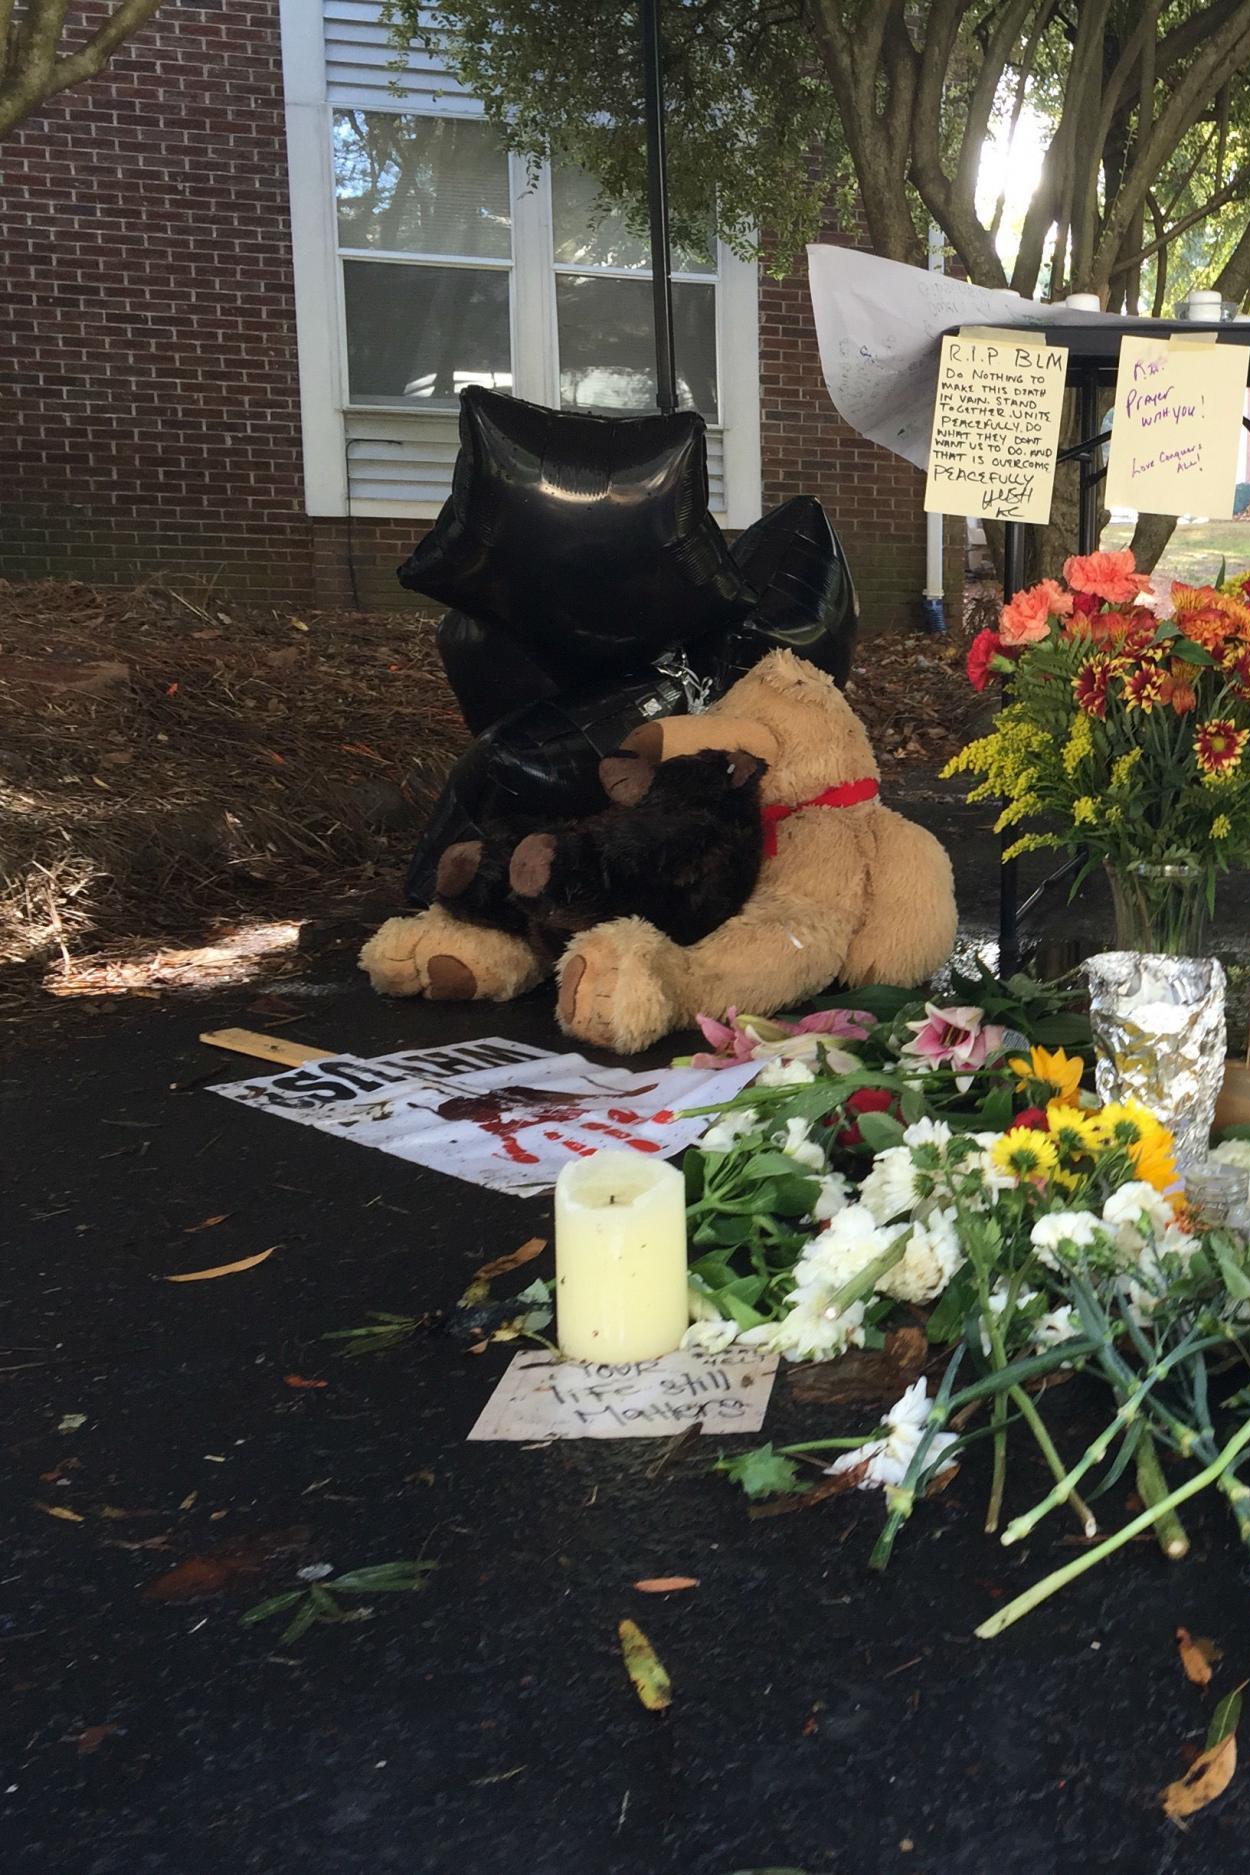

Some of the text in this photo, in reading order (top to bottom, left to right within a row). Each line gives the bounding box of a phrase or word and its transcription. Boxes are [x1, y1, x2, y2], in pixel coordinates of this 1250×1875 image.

[1014, 347, 1063, 372] BLM
[1031, 375, 1045, 385] TO
[940, 381, 1047, 398] MAKE THIS DEATH
[939, 392, 1037, 410] IN VAIN. STAND
[1026, 421, 1042, 432] DO
[937, 428, 972, 440] WHAT
[976, 432, 1008, 445] THEY
[935, 438, 1054, 459] WANT US TO DO. AND
[932, 449, 1051, 473] THAT IS OVERCOME
[934, 464, 1035, 486] PEACEFULLY
